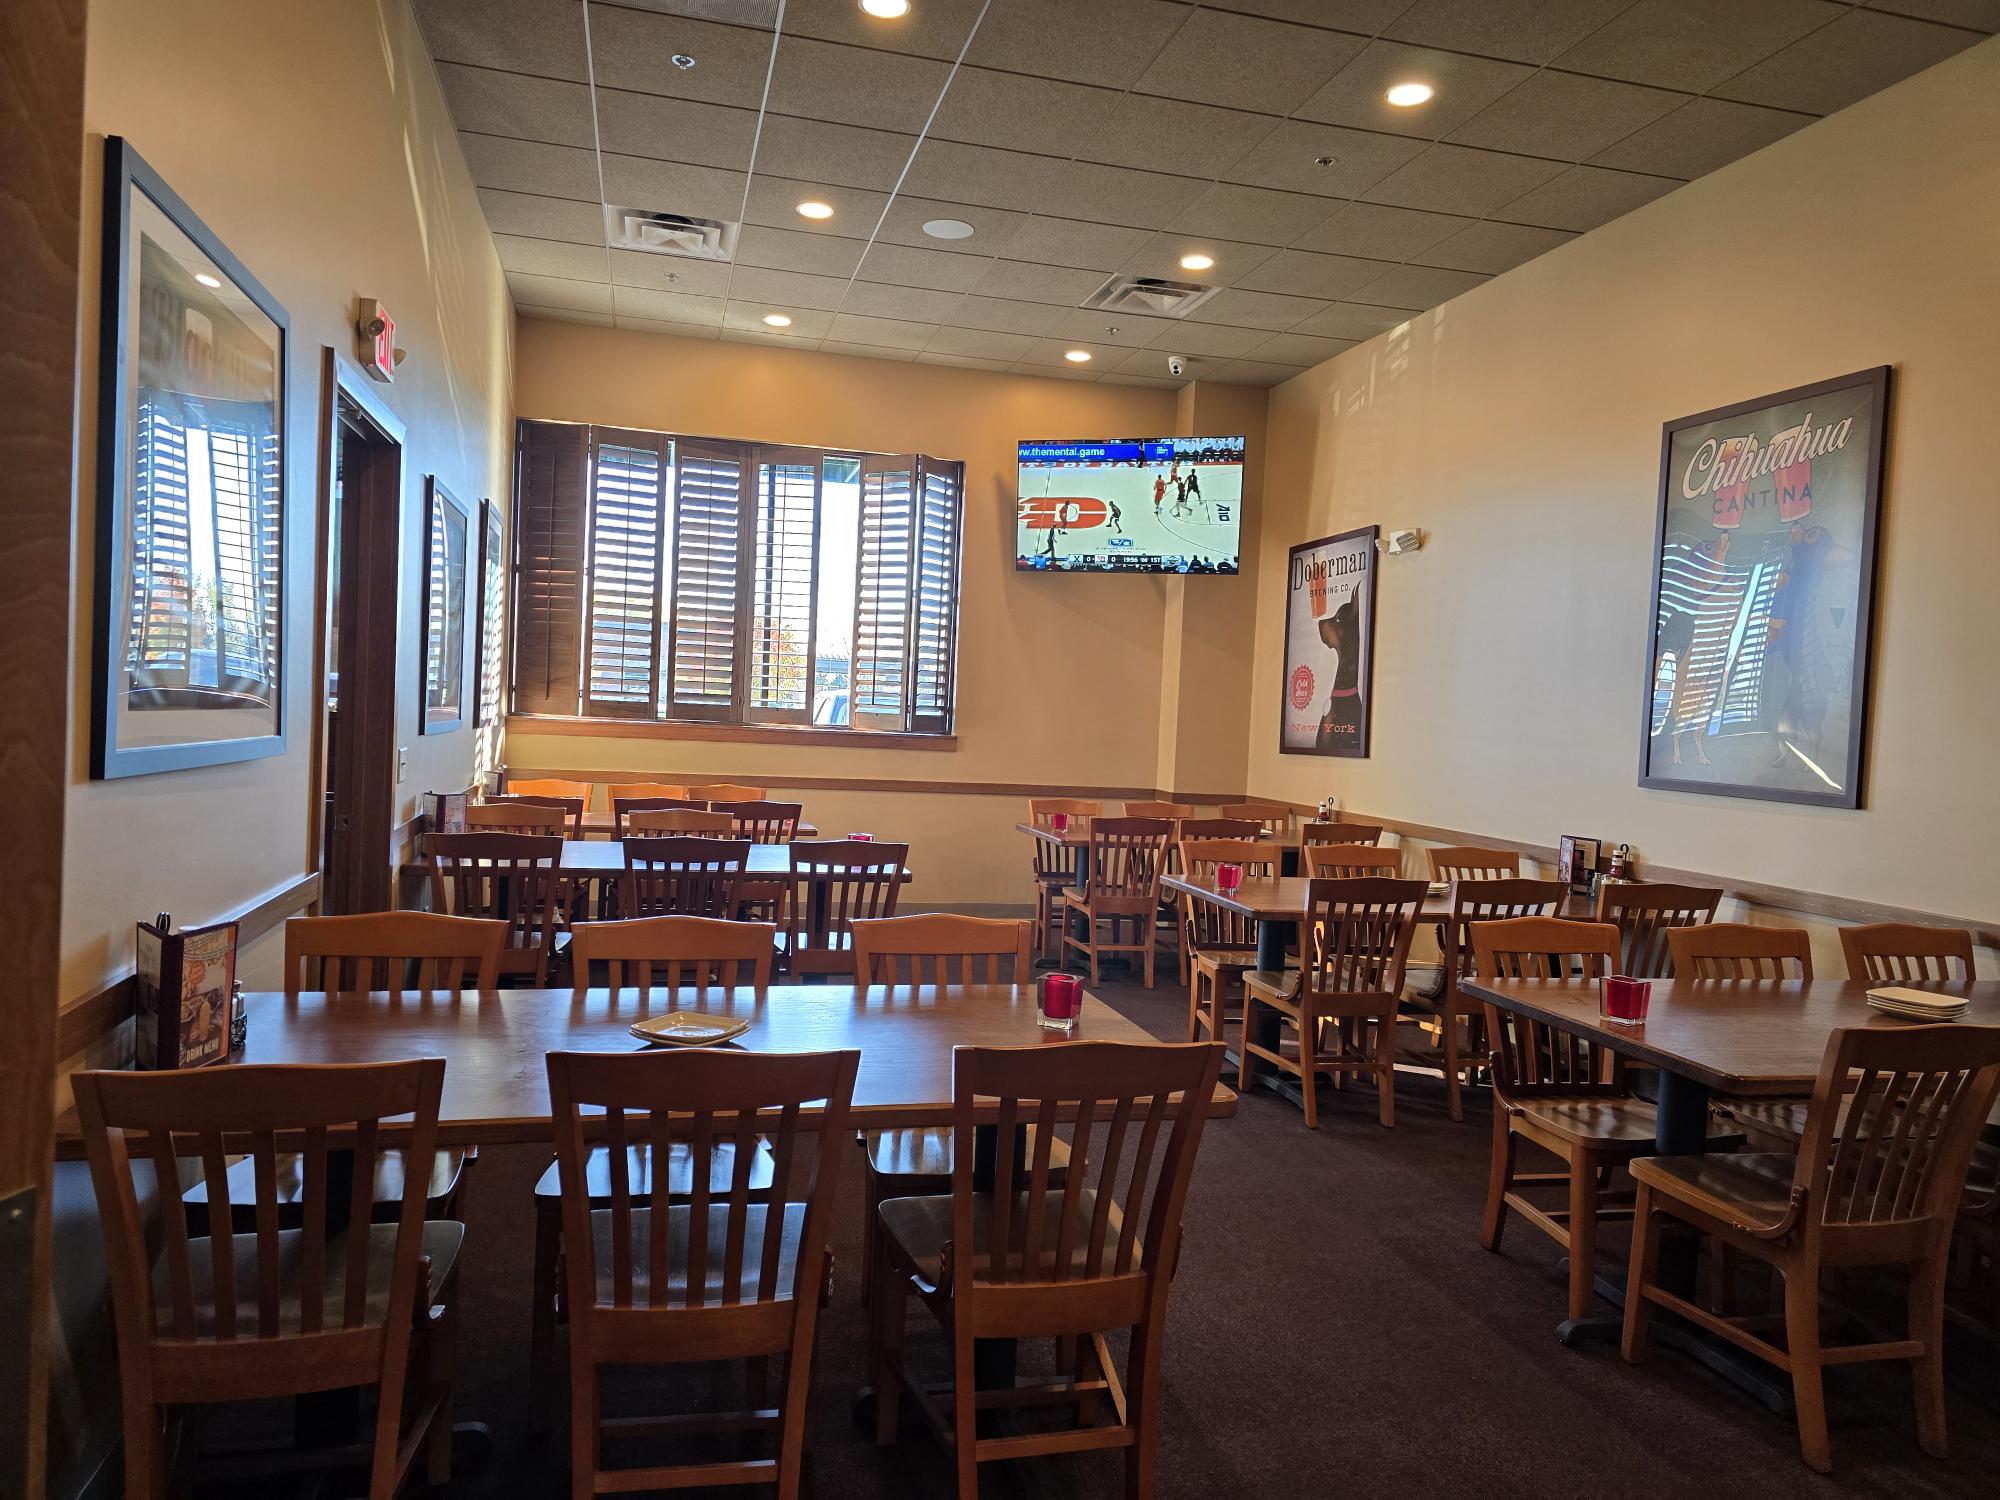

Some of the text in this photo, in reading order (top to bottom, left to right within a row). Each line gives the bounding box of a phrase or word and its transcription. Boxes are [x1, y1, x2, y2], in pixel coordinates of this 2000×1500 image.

[1682, 412, 1853, 500] Chihuahua
[1712, 482, 1814, 514] CANTINA
[1293, 551, 1367, 591] Doberman
[1310, 583, 1351, 598] BREWING CO.
[1291, 723, 1356, 733] New York
